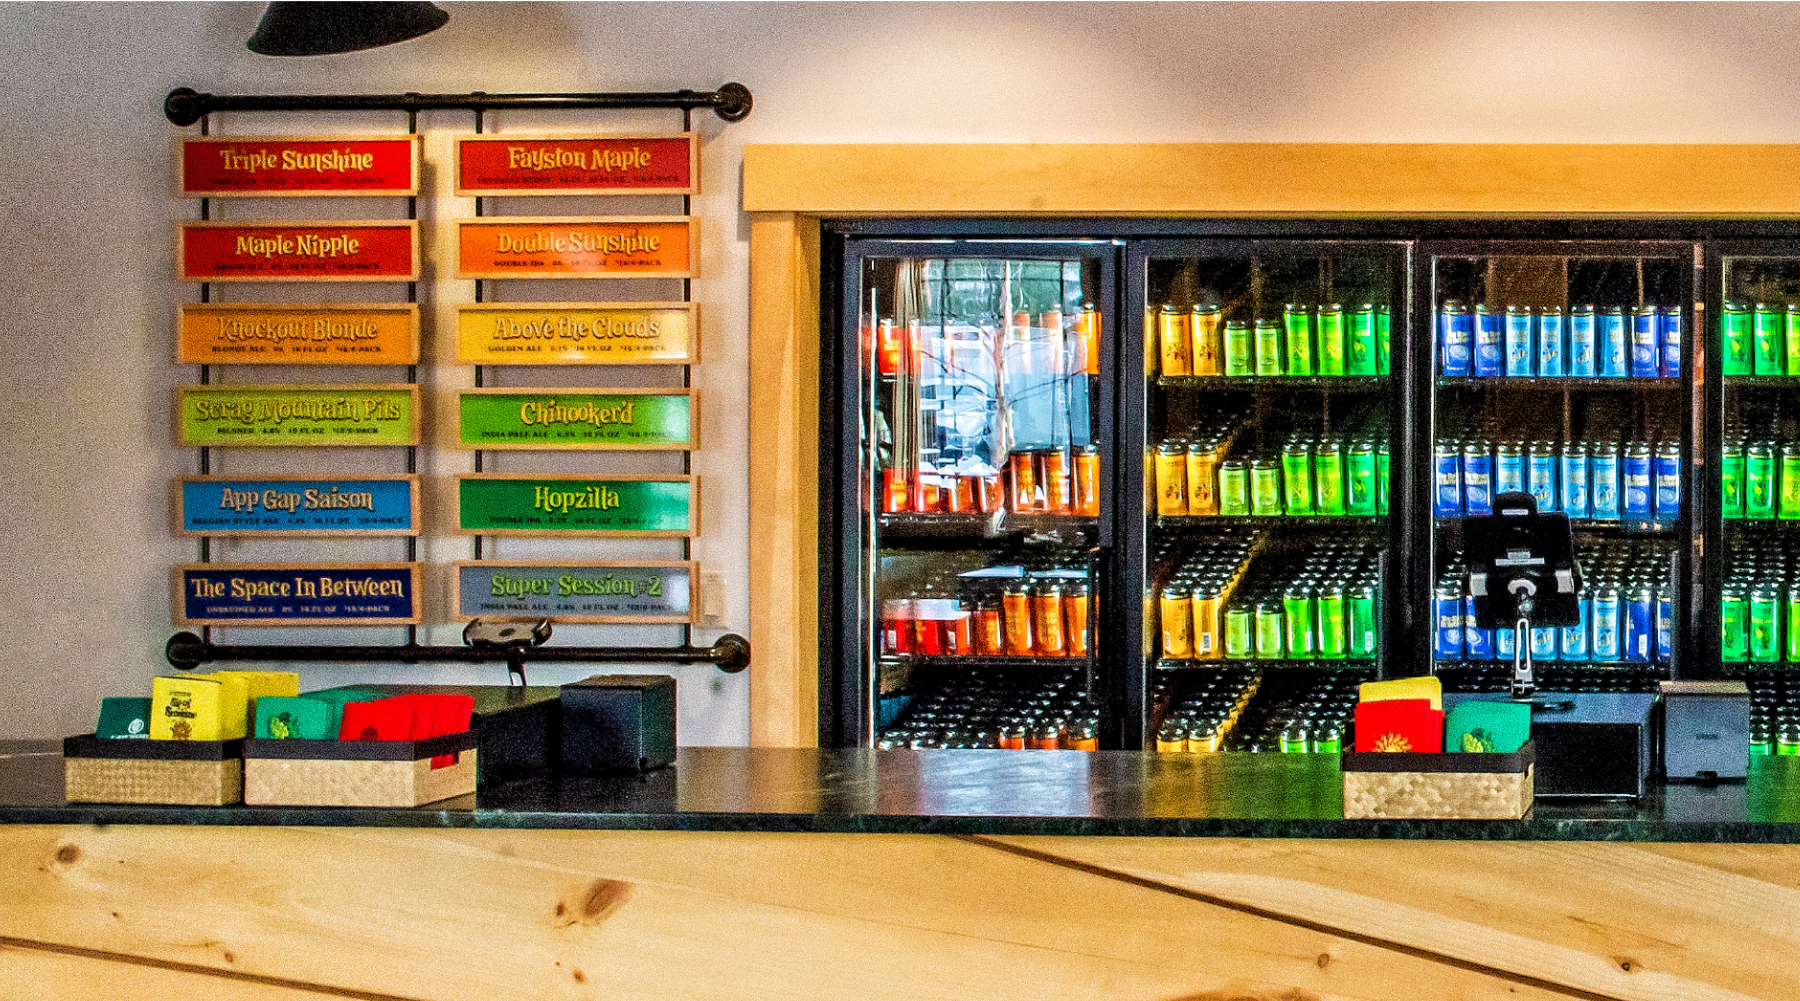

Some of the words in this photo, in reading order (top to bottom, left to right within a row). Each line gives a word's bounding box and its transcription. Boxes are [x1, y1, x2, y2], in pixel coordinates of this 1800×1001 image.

[220, 149, 278, 173] Triple
[282, 148, 374, 173] Sunshine
[508, 147, 587, 172] Fayston
[590, 147, 651, 172] Maple
[236, 235, 294, 258] Maple
[296, 234, 360, 258] Nipple
[497, 231, 567, 254] Double
[568, 229, 661, 255] Sunshine
[218, 317, 306, 342] Knockout
[312, 318, 377, 341] Blonde
[493, 317, 554, 340] Above
[558, 316, 589, 341] the
[592, 316, 660, 339] Clouds
[195, 399, 255, 423] Scrag
[259, 398, 360, 424] Mountain
[363, 397, 401, 420] Pils
[520, 400, 635, 427] Chinooker'd
[220, 488, 259, 512] App
[262, 489, 301, 512] Gap
[304, 487, 374, 511] Saison
[534, 486, 620, 513] Hopzilla
[191, 578, 225, 598] The
[230, 578, 290, 601] Space
[295, 577, 317, 598] In
[320, 577, 404, 598] Between
[491, 575, 553, 599] Super
[558, 573, 637, 598] Session
[639, 577, 663, 597] #2
